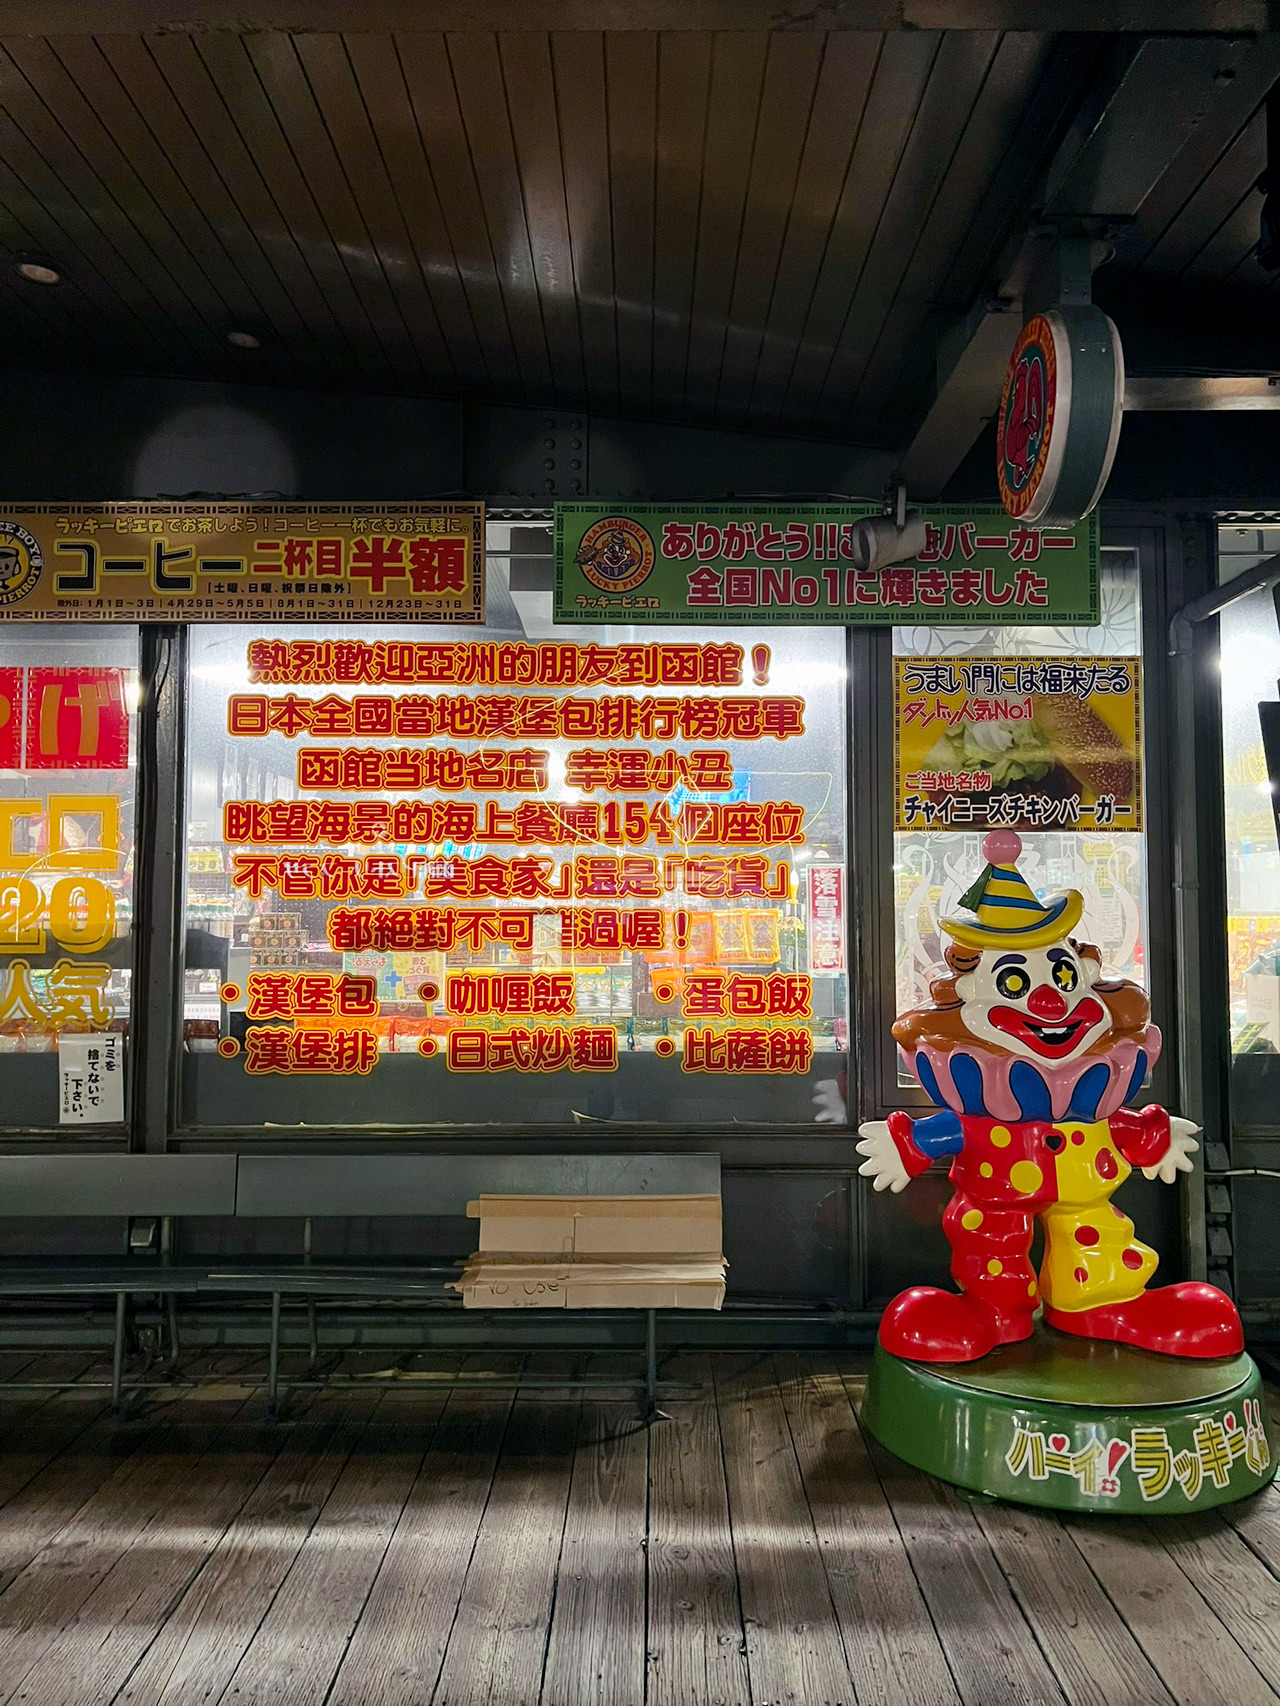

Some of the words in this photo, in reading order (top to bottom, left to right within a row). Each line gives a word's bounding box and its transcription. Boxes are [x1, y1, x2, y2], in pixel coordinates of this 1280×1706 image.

[585, 519, 648, 544] HAMBURGER
[0, 566, 40, 604] IERROT
[586, 566, 620, 590] LUCKY
[622, 550, 653, 590] PIERROT
[686, 566, 1049, 608] 全国No1に輝きました
[576, 595, 661, 609] ラッキーピエロ
[903, 663, 1133, 700] うまい門には福来たる
[228, 694, 806, 738] 日本全國當地漢堡包排行榜冠軍
[297, 748, 550, 792] 函館当地名店
[566, 749, 734, 793] 幸運小丑
[903, 770, 993, 792] ご当地名物
[223, 801, 806, 845] 眺望海景的海上餐廳154個座位
[903, 793, 1133, 825] チャイニーズチキンバーガー
[233, 855, 791, 899] 不管你是「美食家」還是「吃貨」
[813, 868, 841, 967] 落雪注意
[0, 957, 116, 1029] 人気
[247, 973, 380, 1020] 漢堡包
[683, 973, 813, 1018] 蛋包飯
[105, 1036, 117, 1072] ゴミを
[245, 1026, 381, 1075] 漢堡排
[682, 1027, 813, 1074] 比薩餅
[87, 1048, 100, 1107] 捨てないで
